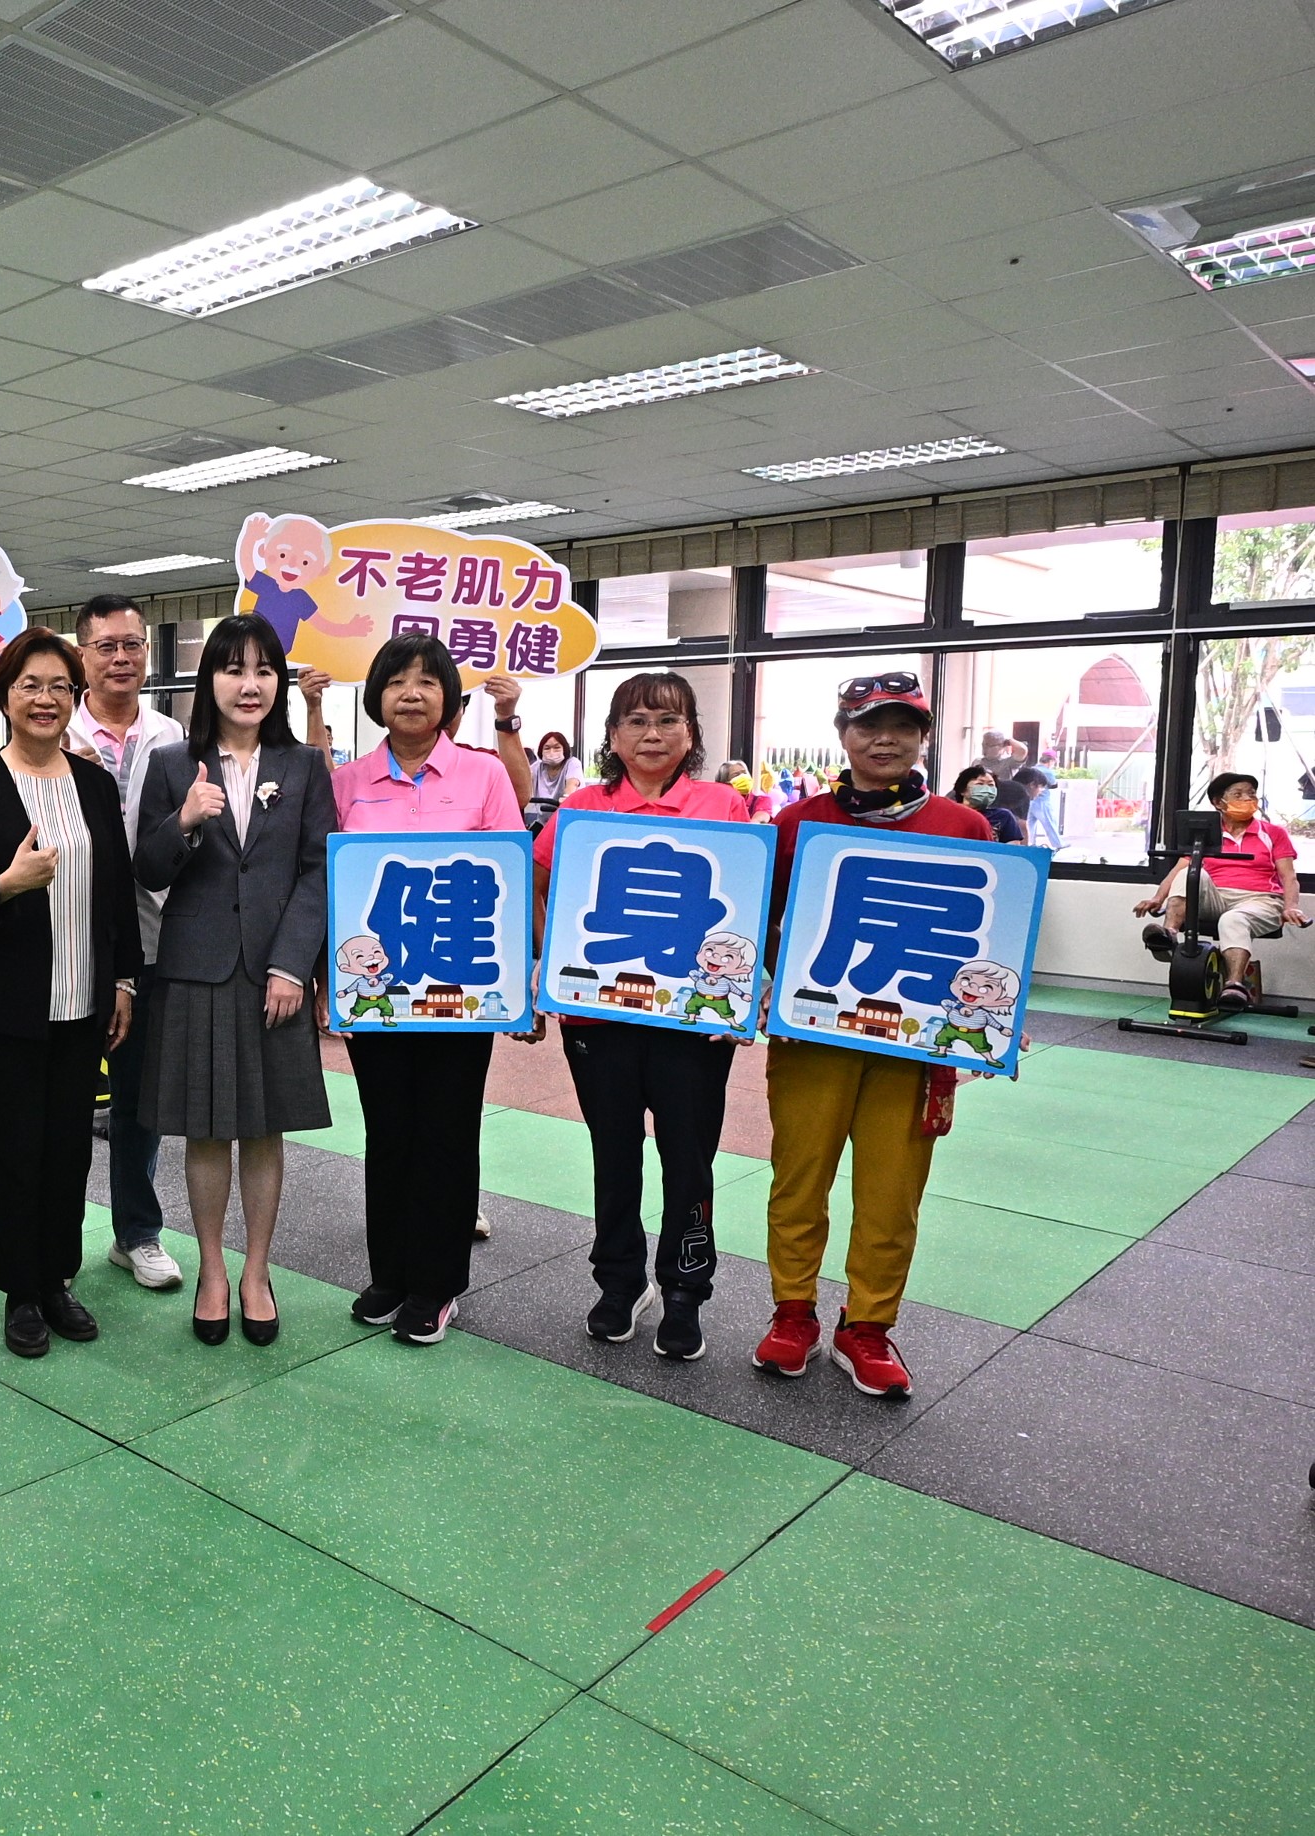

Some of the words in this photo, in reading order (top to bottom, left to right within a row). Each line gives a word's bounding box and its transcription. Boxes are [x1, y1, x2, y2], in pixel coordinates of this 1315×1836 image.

[338, 549, 562, 611] 不老肌力
[367, 860, 500, 986] 健
[584, 841, 728, 979] 身
[809, 855, 987, 1006] 房
